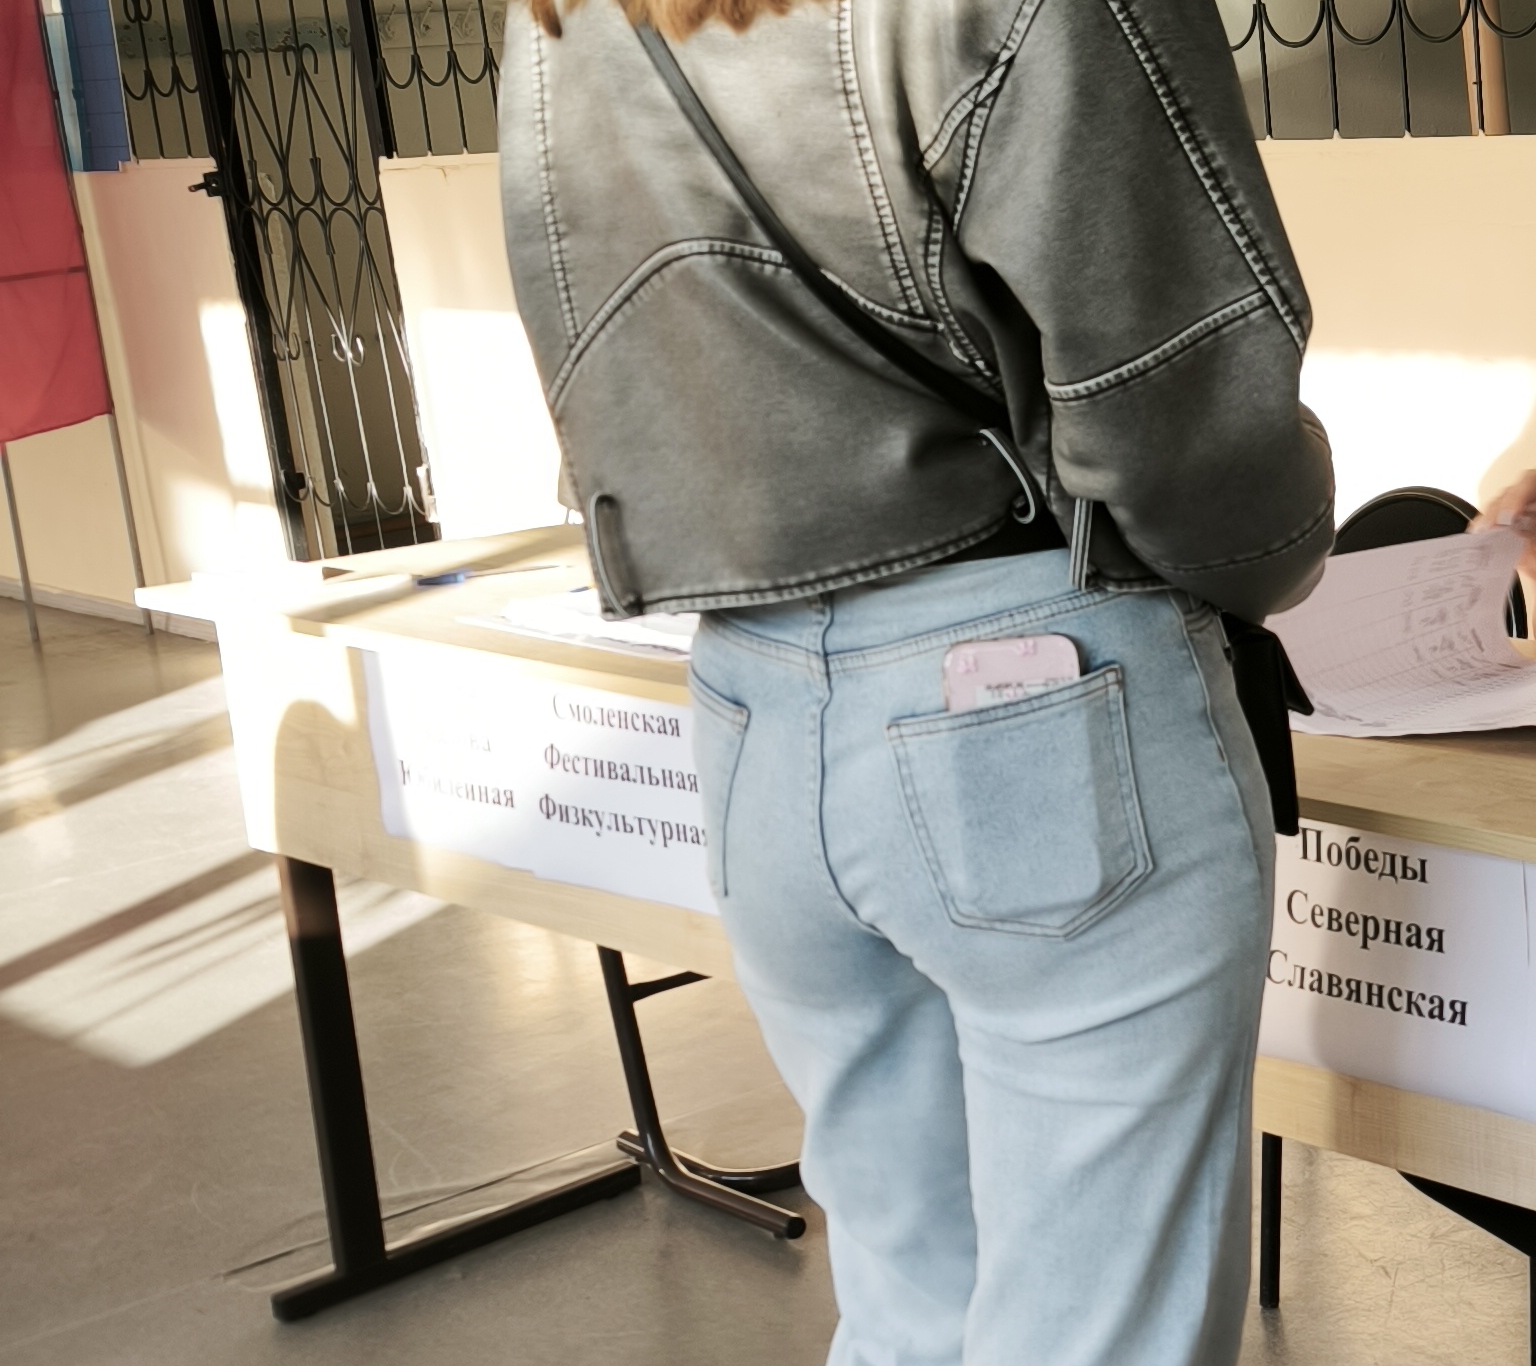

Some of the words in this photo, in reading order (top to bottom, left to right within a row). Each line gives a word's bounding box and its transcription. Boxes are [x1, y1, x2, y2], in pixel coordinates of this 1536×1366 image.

[552, 692, 681, 738] Смоленская
[543, 742, 700, 794] Фестивальная
[1300, 827, 1429, 884] Победы
[1286, 888, 1446, 955] Северная
[1266, 949, 1469, 1027] Славянская
